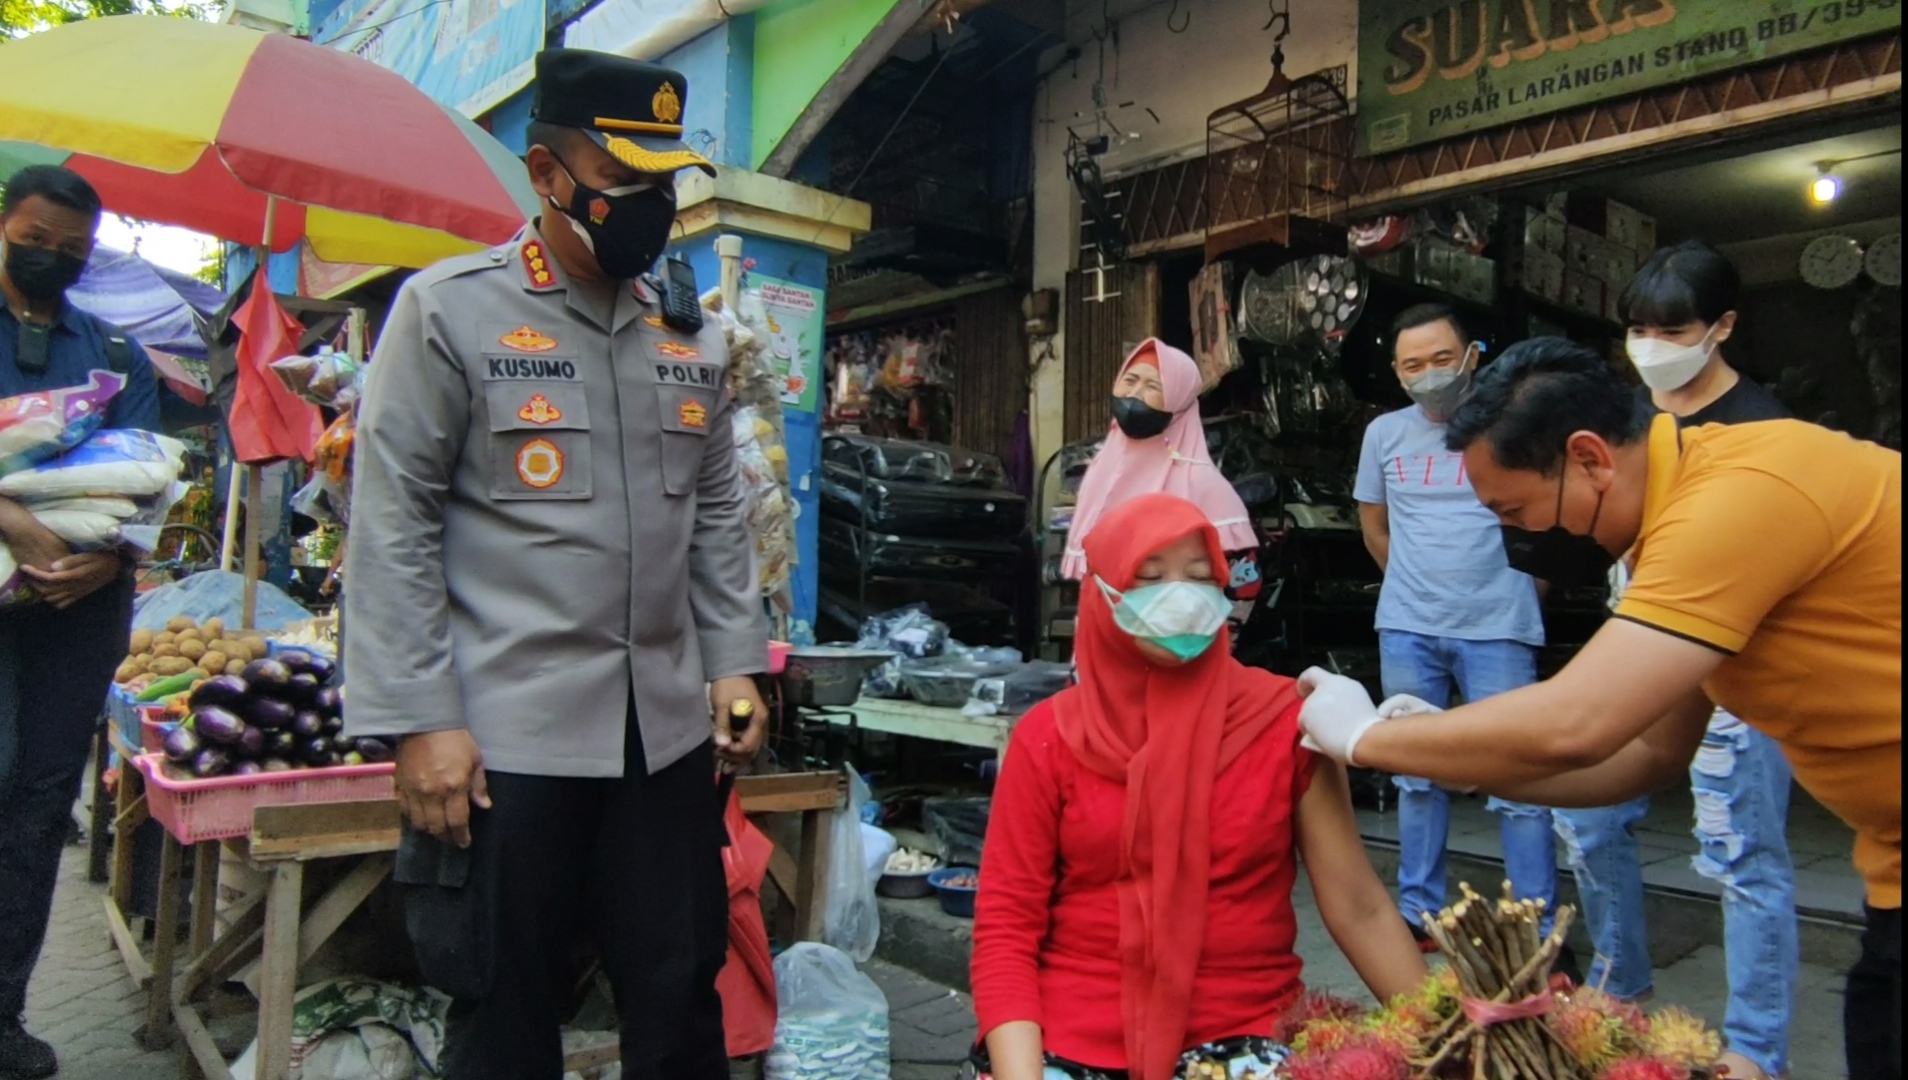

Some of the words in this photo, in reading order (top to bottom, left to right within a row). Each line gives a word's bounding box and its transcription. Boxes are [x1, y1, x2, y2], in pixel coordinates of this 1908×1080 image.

[1429, 93, 1499, 126] PASAR
[1508, 53, 1645, 105] LARANGAN
[489, 357, 576, 380] KUSUMO
[655, 363, 716, 386] POLRI
